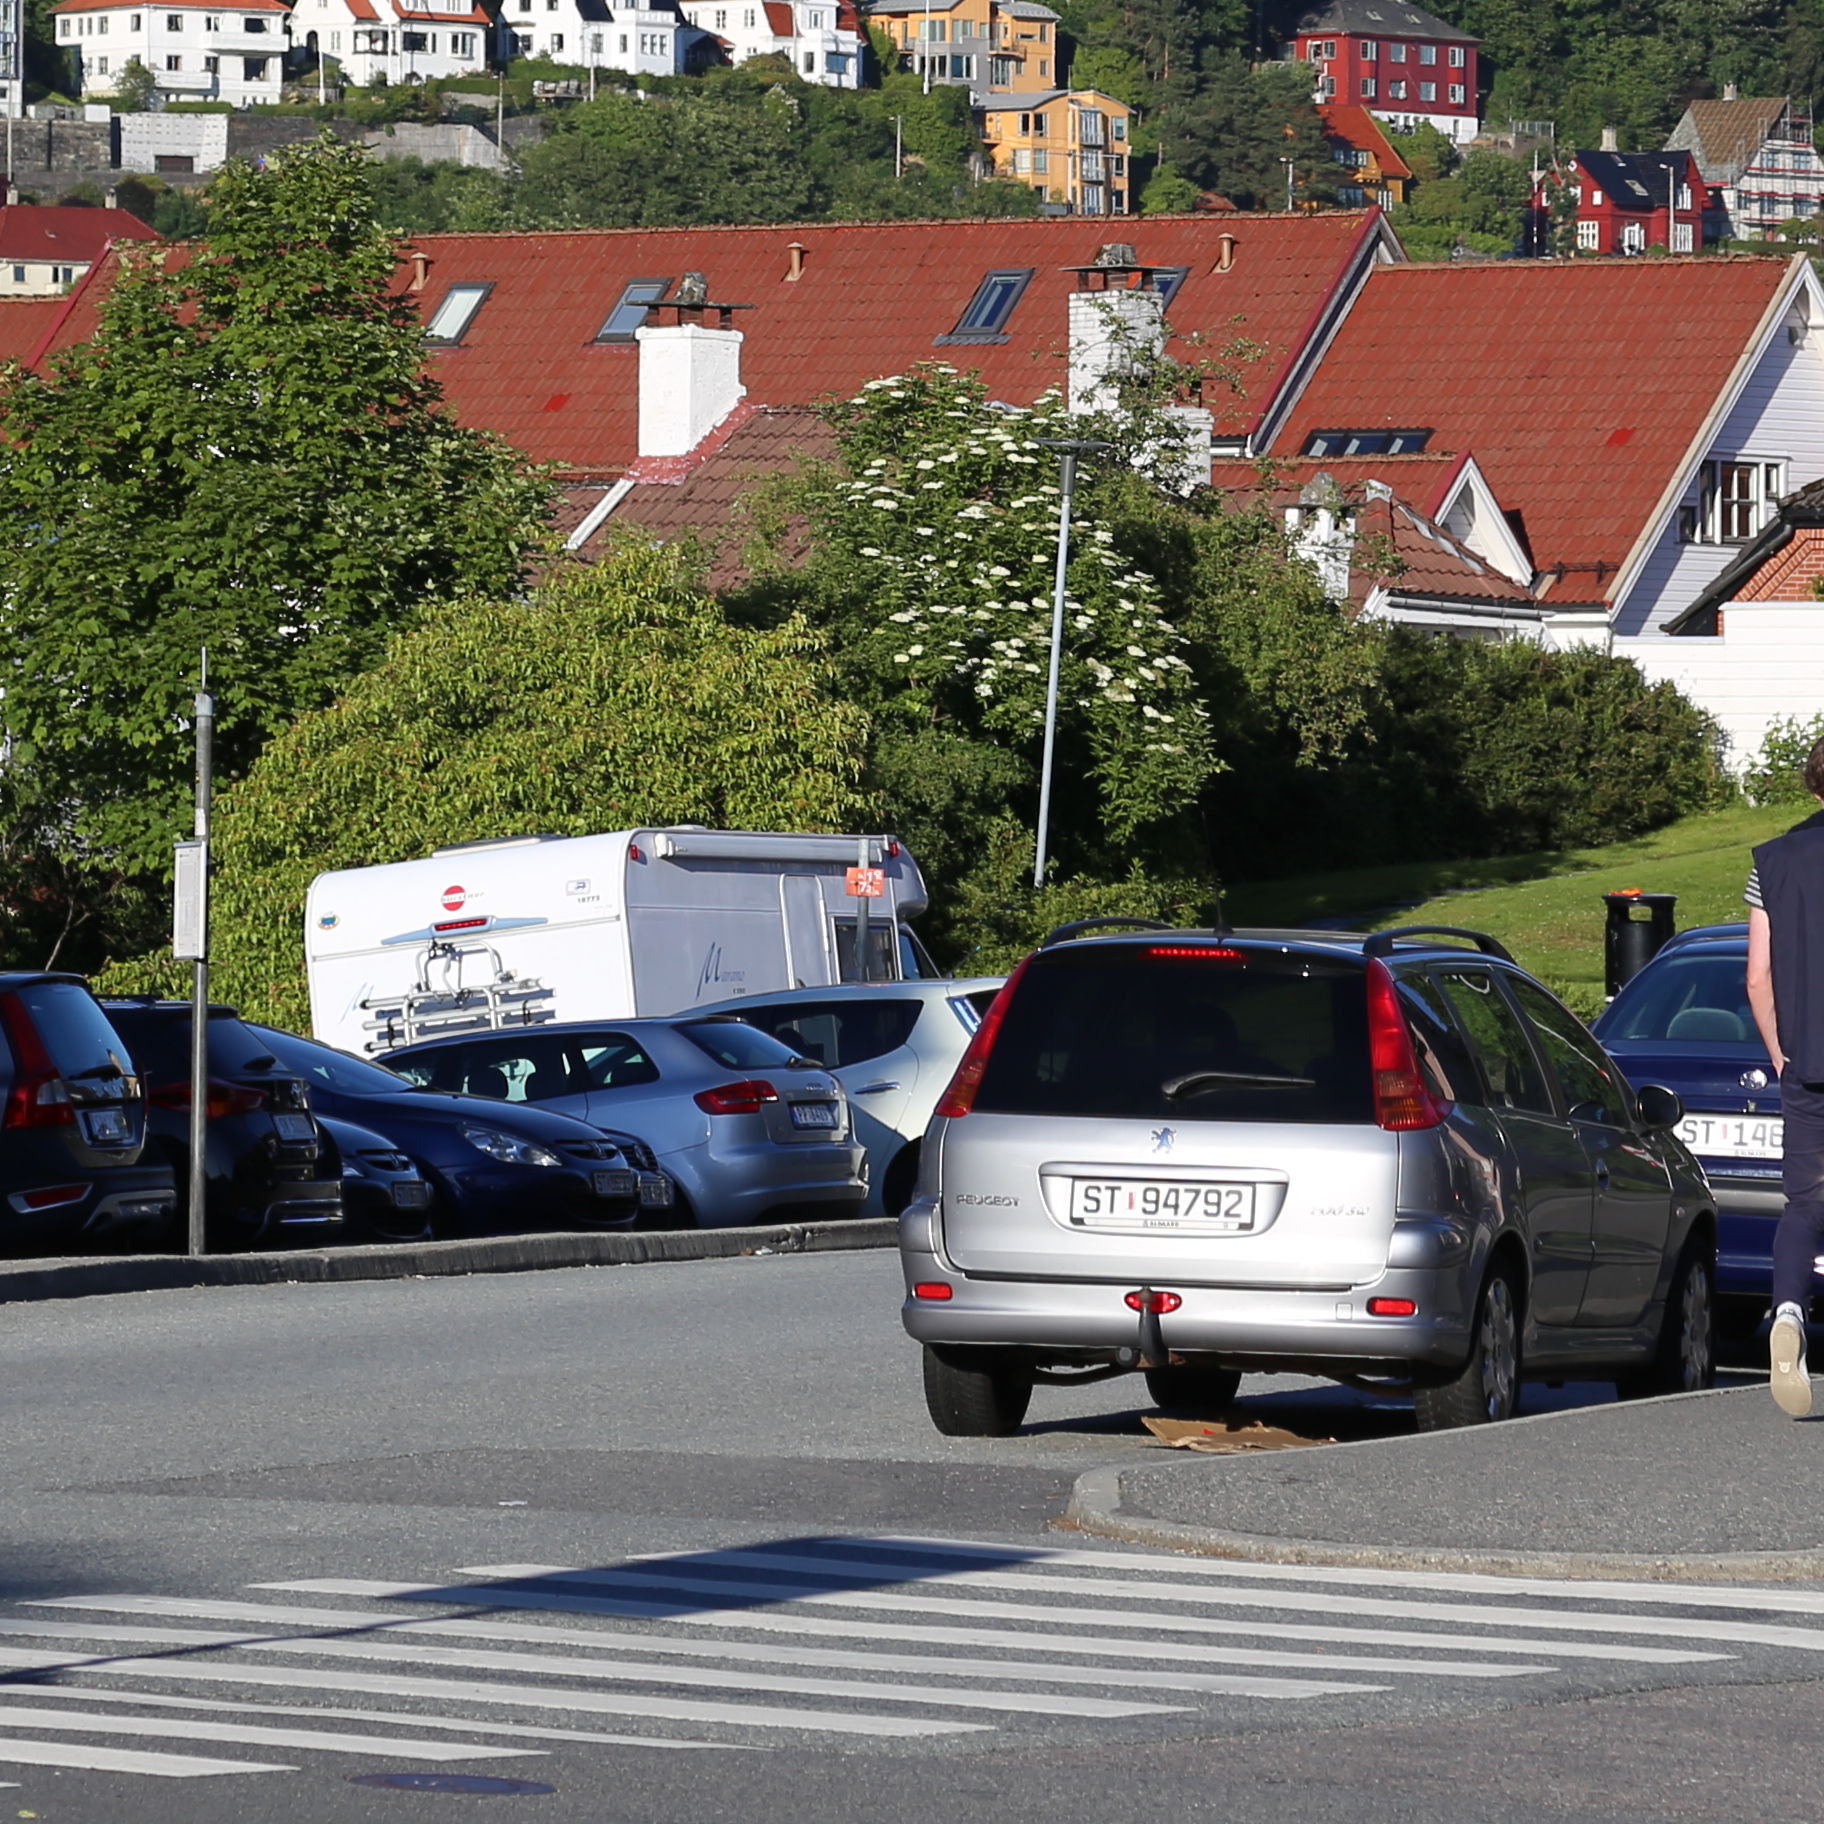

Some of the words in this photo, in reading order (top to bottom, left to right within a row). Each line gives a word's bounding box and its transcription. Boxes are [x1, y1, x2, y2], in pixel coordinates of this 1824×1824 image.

[1681, 1119, 1716, 1145] ST
[1732, 1121, 1784, 1148] 146
[1083, 1185, 1122, 1214] ST
[1141, 1186, 1243, 1218] 94792
